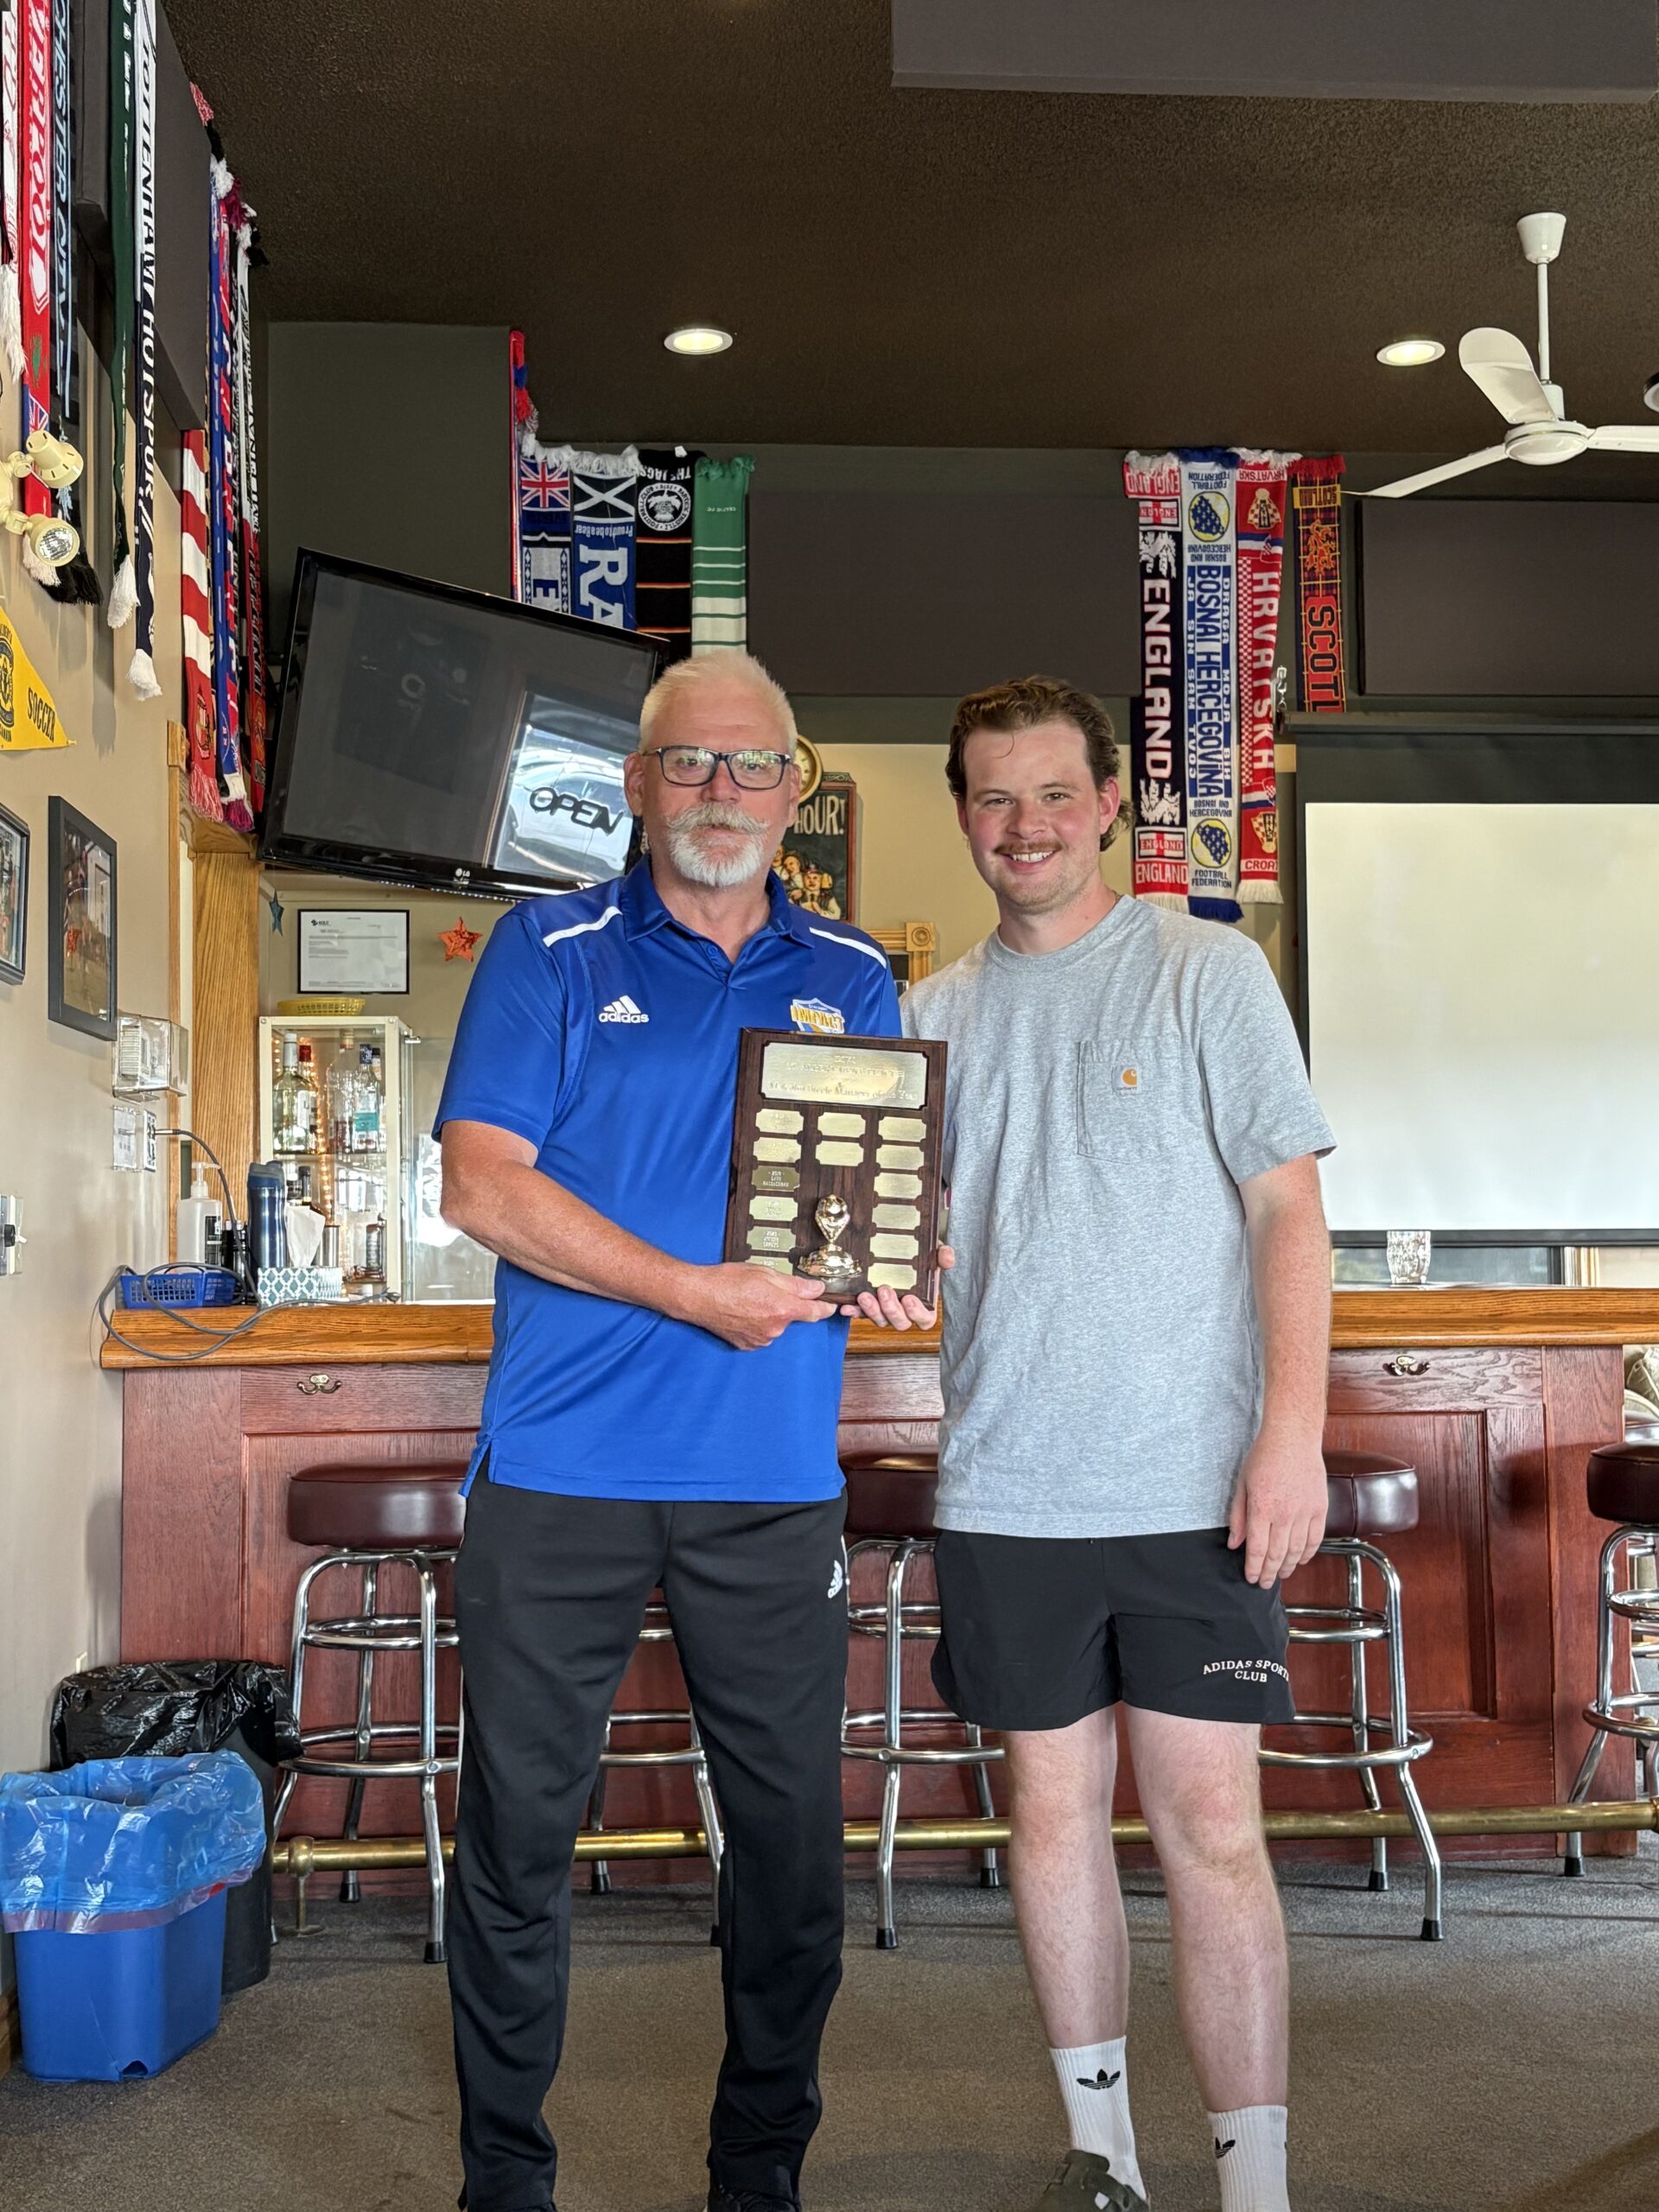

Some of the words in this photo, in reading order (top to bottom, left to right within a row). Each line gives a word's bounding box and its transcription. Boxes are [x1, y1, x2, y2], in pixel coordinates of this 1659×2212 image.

[141, 40, 155, 286] TOTTENHAM
[142, 308, 155, 500] HOTSPUR
[1192, 480, 1228, 490] FOOTBALL
[1299, 487, 1338, 505] SCOTLAND
[1186, 575, 1196, 601] JA
[1196, 565, 1223, 643] BOSNAI
[1222, 576, 1231, 645] DRAGA
[1143, 578, 1173, 779] ENGLAND
[1187, 668, 1197, 710] SAM
[1222, 669, 1231, 723] MOJA
[28, 686, 55, 744] SOCCER
[529, 786, 624, 835] OPEN
[1135, 864, 1189, 885] ENGLAND
[1192, 878, 1232, 889] FEDERATION
[1195, 869, 1228, 880] FOOTBALL
[598, 1012, 650, 1024] adidas
[791, 1005, 845, 1032] IMPACT
[1203, 1659, 1253, 1675] ADIDAS
[1255, 1659, 1289, 1682] SPORT
[1234, 1670, 1268, 1683] CLUB
